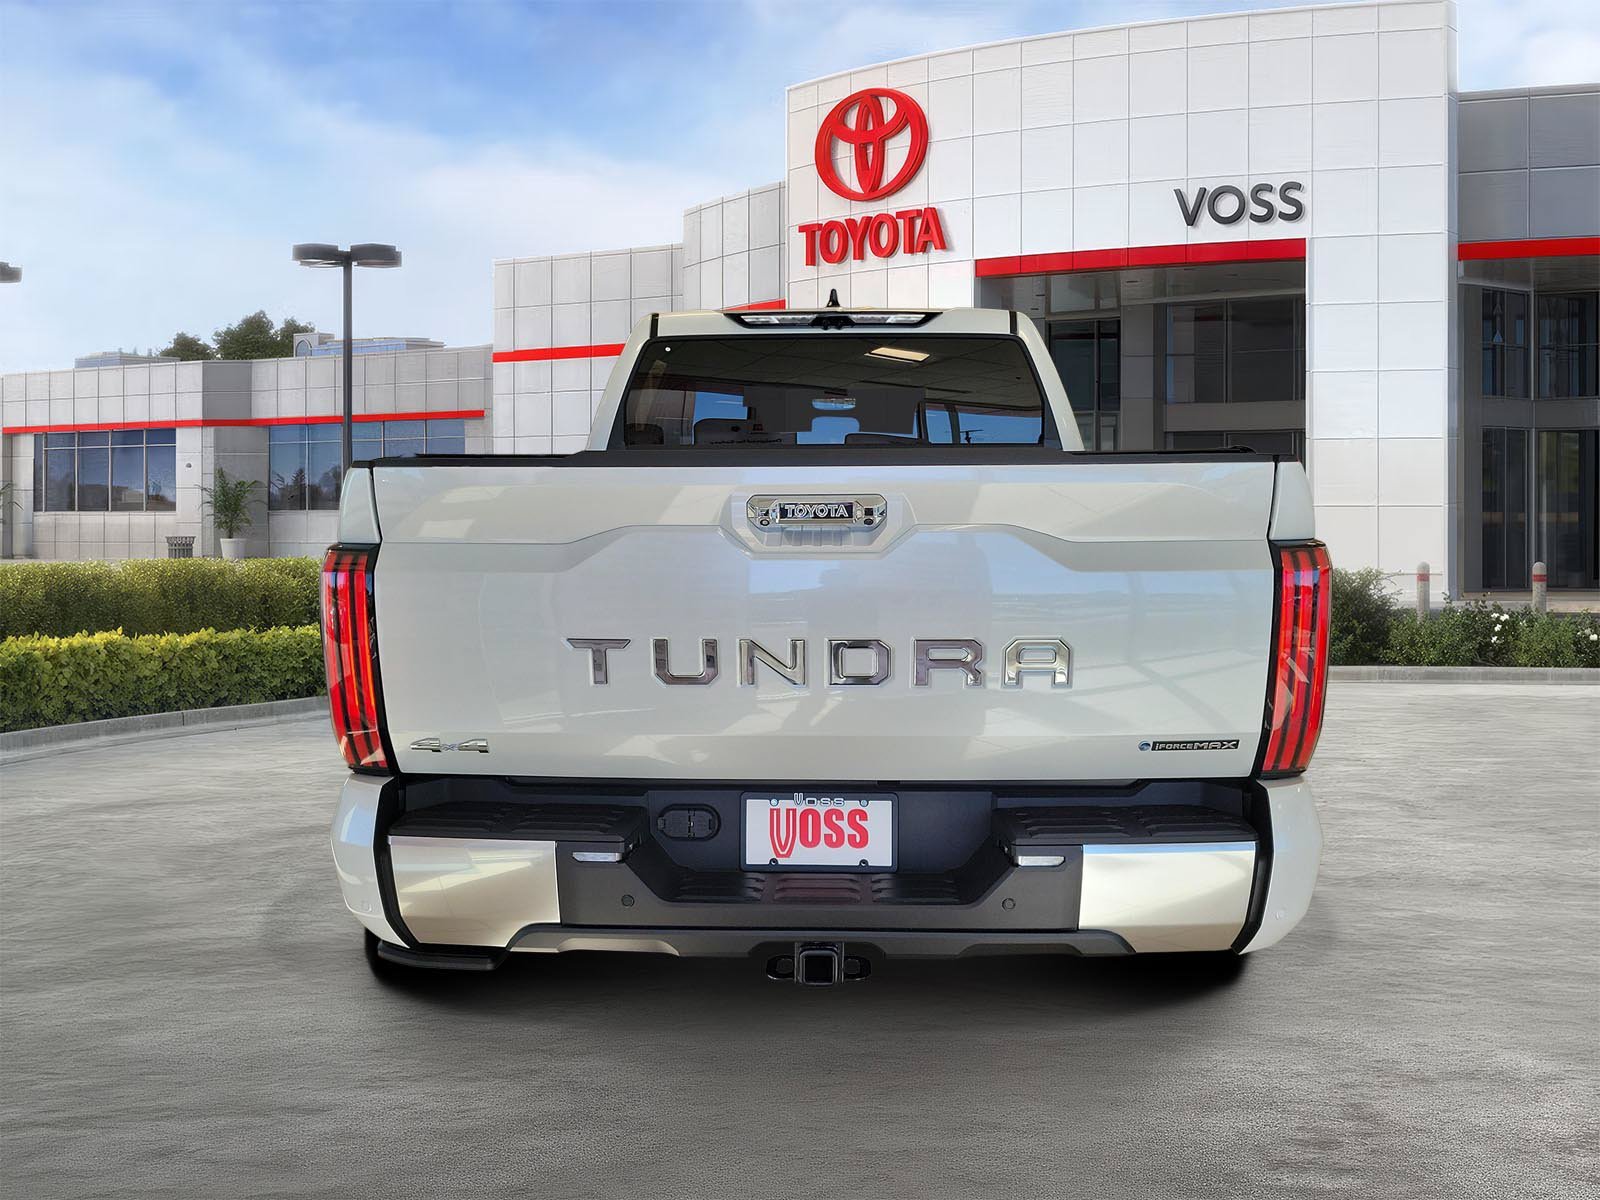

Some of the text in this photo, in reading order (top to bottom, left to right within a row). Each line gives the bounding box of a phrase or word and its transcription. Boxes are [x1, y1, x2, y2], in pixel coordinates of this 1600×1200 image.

[1173, 181, 1305, 228] VOSS
[798, 206, 948, 267] TOYOTA
[785, 504, 848, 517] TOYOTA
[564, 637, 1075, 688] TUNDRA
[769, 808, 869, 858] VOSS
